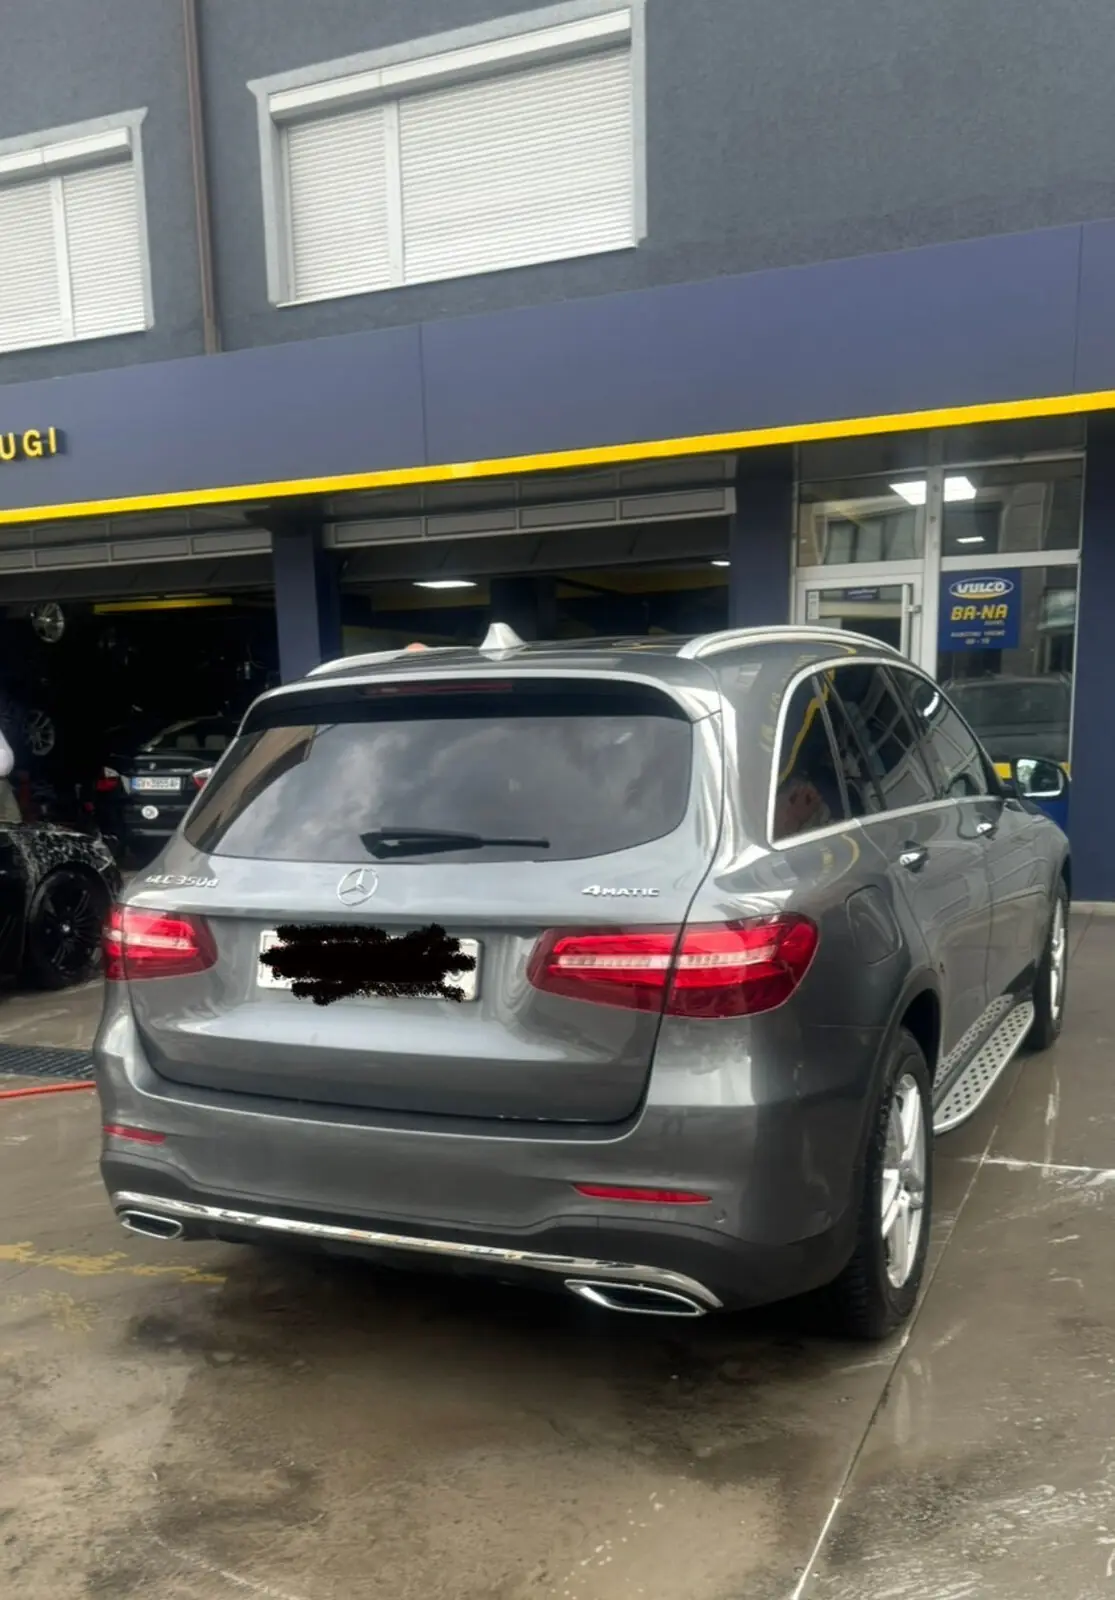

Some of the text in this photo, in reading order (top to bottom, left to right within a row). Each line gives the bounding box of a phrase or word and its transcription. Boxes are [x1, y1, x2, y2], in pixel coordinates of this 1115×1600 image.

[0, 426, 56, 460] UGI
[957, 581, 1006, 594] VULCO
[951, 604, 1008, 620] BA-NA
[581, 884, 661, 897] 4MATIC
